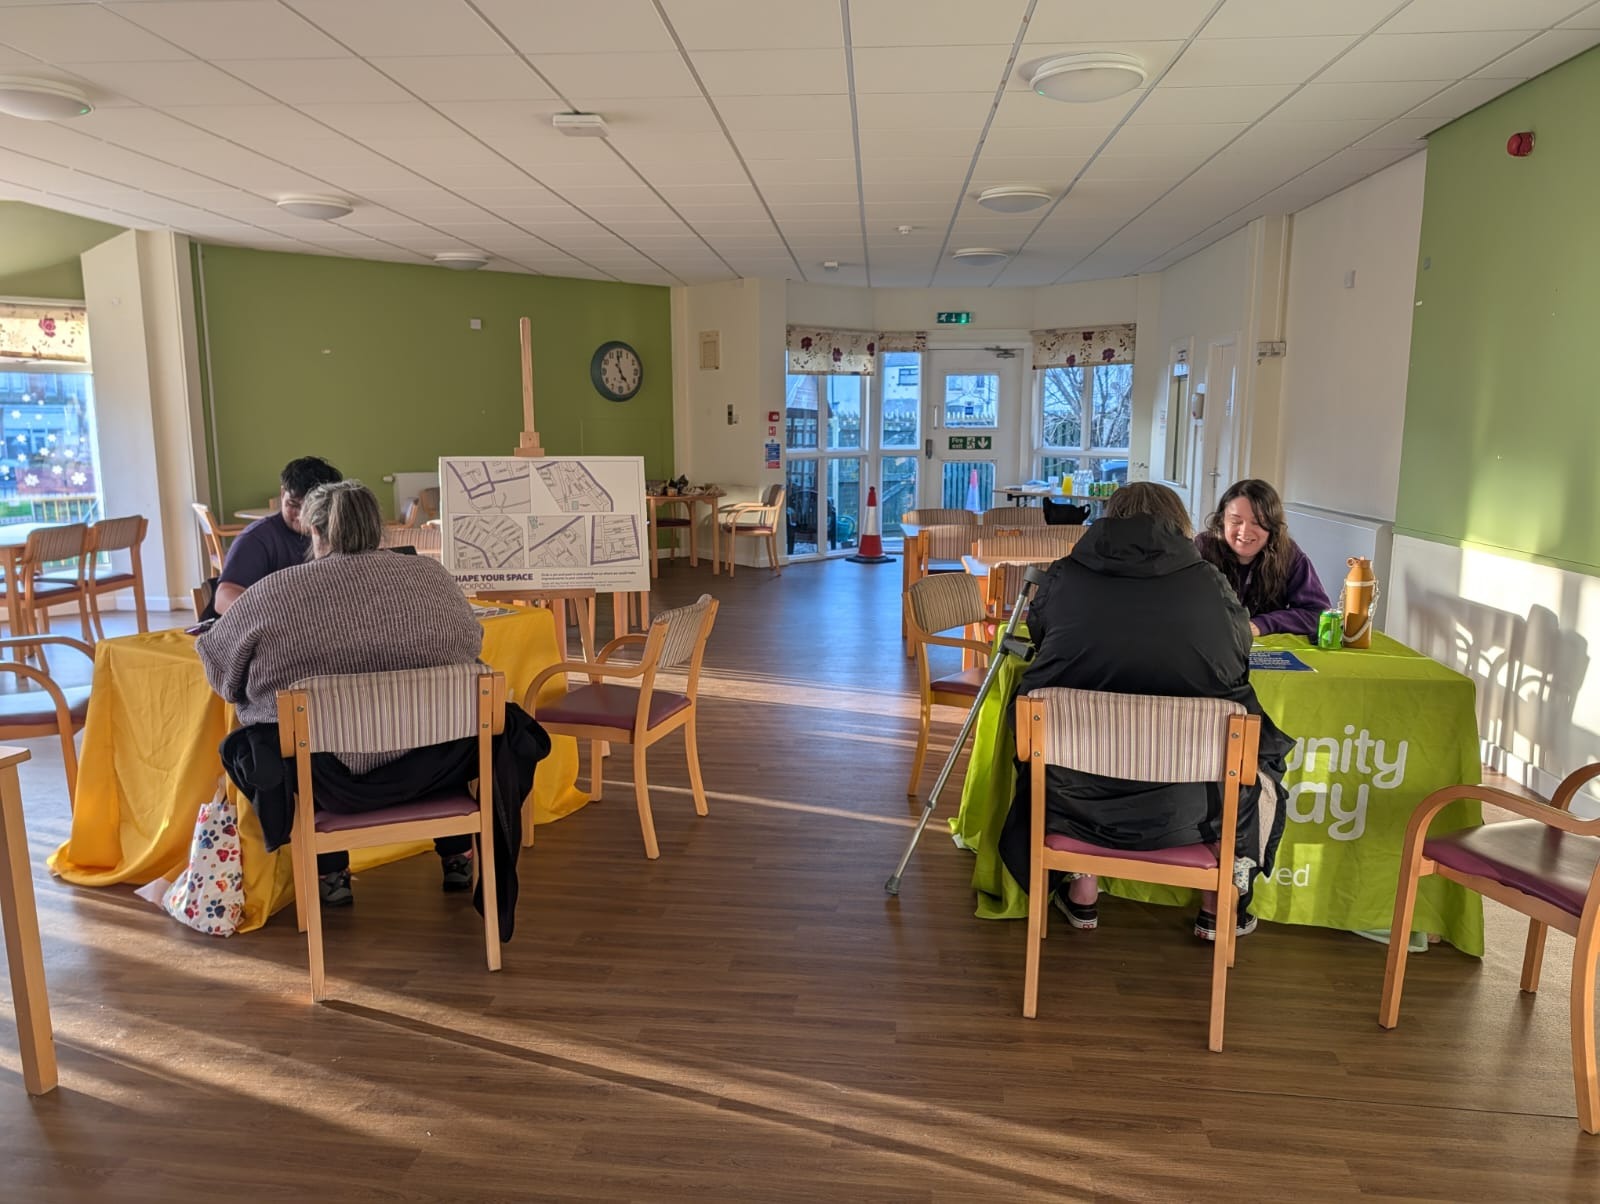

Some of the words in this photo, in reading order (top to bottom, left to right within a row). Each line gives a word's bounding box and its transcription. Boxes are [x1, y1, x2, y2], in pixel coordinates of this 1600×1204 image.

[451, 574, 480, 583] HAPE
[480, 574, 505, 582] YOUR
[506, 573, 534, 581] SPACE
